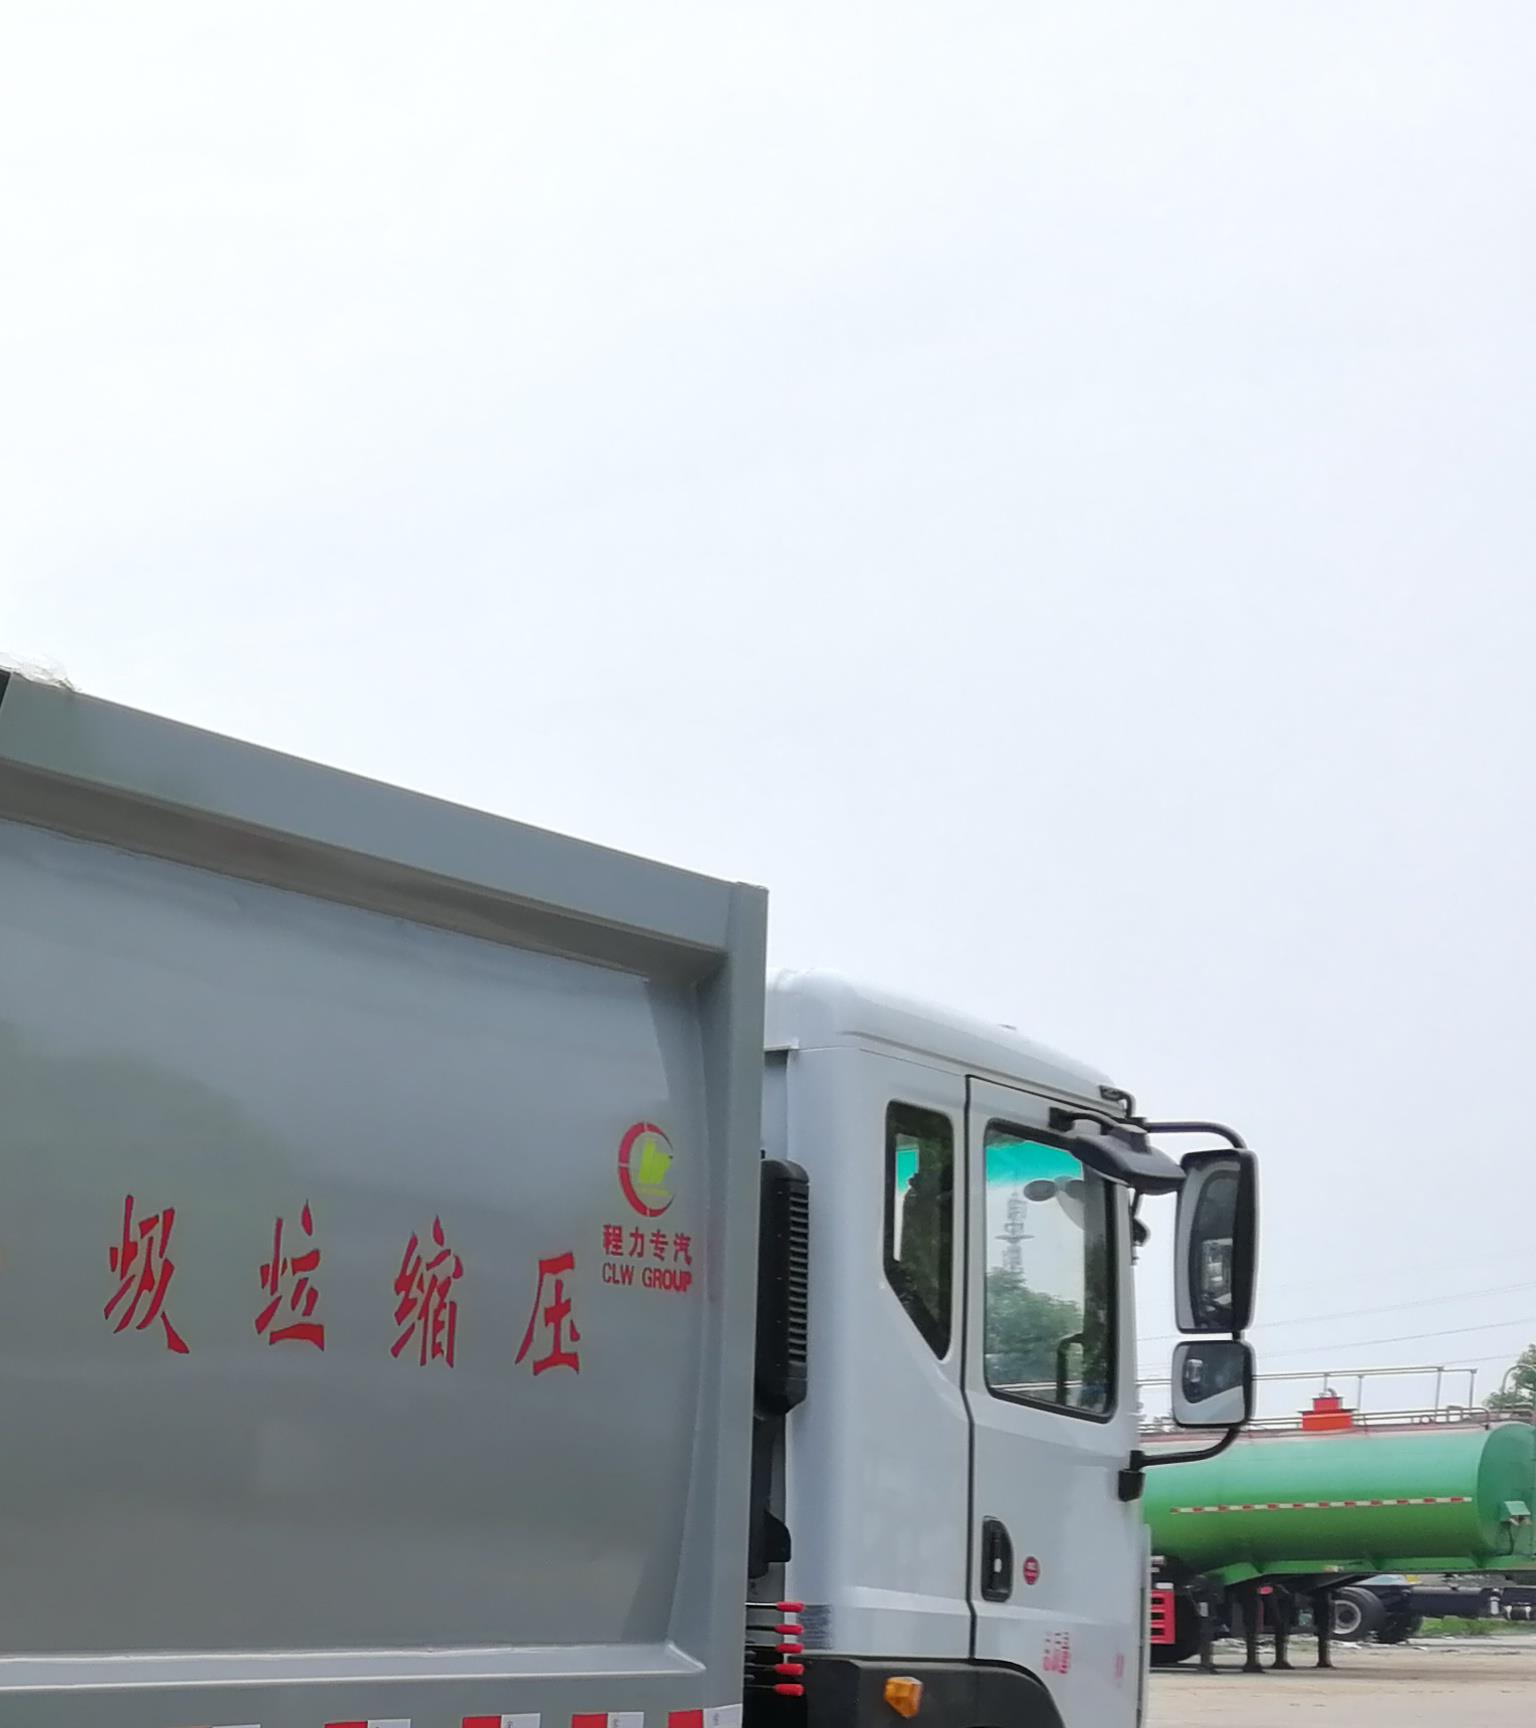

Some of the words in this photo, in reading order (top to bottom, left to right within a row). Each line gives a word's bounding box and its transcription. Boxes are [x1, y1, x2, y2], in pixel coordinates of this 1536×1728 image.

[602, 1224, 693, 1266] 程力专汽
[602, 1262, 634, 1286] CLW
[642, 1266, 693, 1292] GROUP
